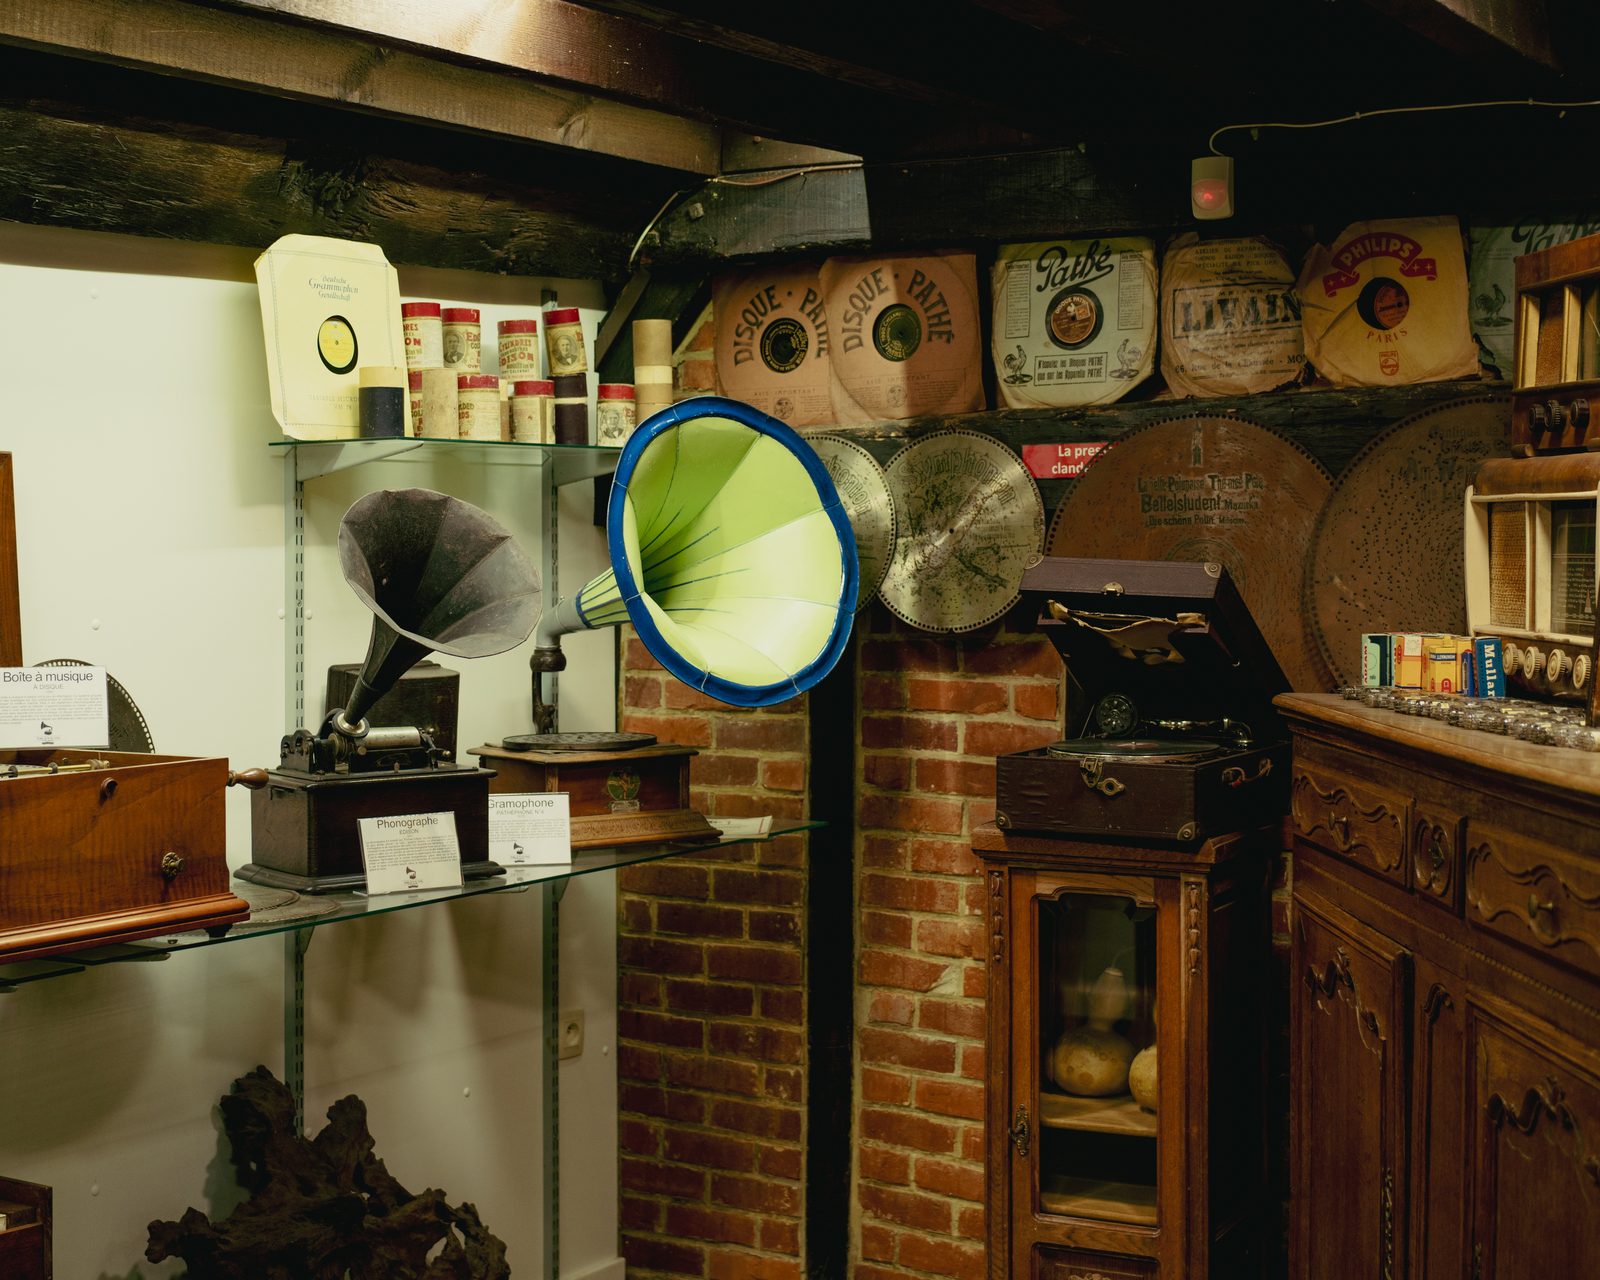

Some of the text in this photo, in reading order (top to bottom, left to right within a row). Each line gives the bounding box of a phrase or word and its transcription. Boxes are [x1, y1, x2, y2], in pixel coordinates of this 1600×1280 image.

[1341, 238, 1414, 266] PHILIPS
[1036, 240, 1114, 292] Pathé
[308, 278, 359, 294] Grammophon
[843, 267, 889, 354] DISQUE
[734, 285, 784, 367] DISQUE
[1367, 328, 1408, 343] PARIS
[1058, 445, 1071, 457] La
[901, 450, 1016, 505] Symphonion
[3, 671, 94, 684] Boîte à musique
[488, 799, 554, 809] Gramophone
[376, 816, 439, 829] Phonographe
